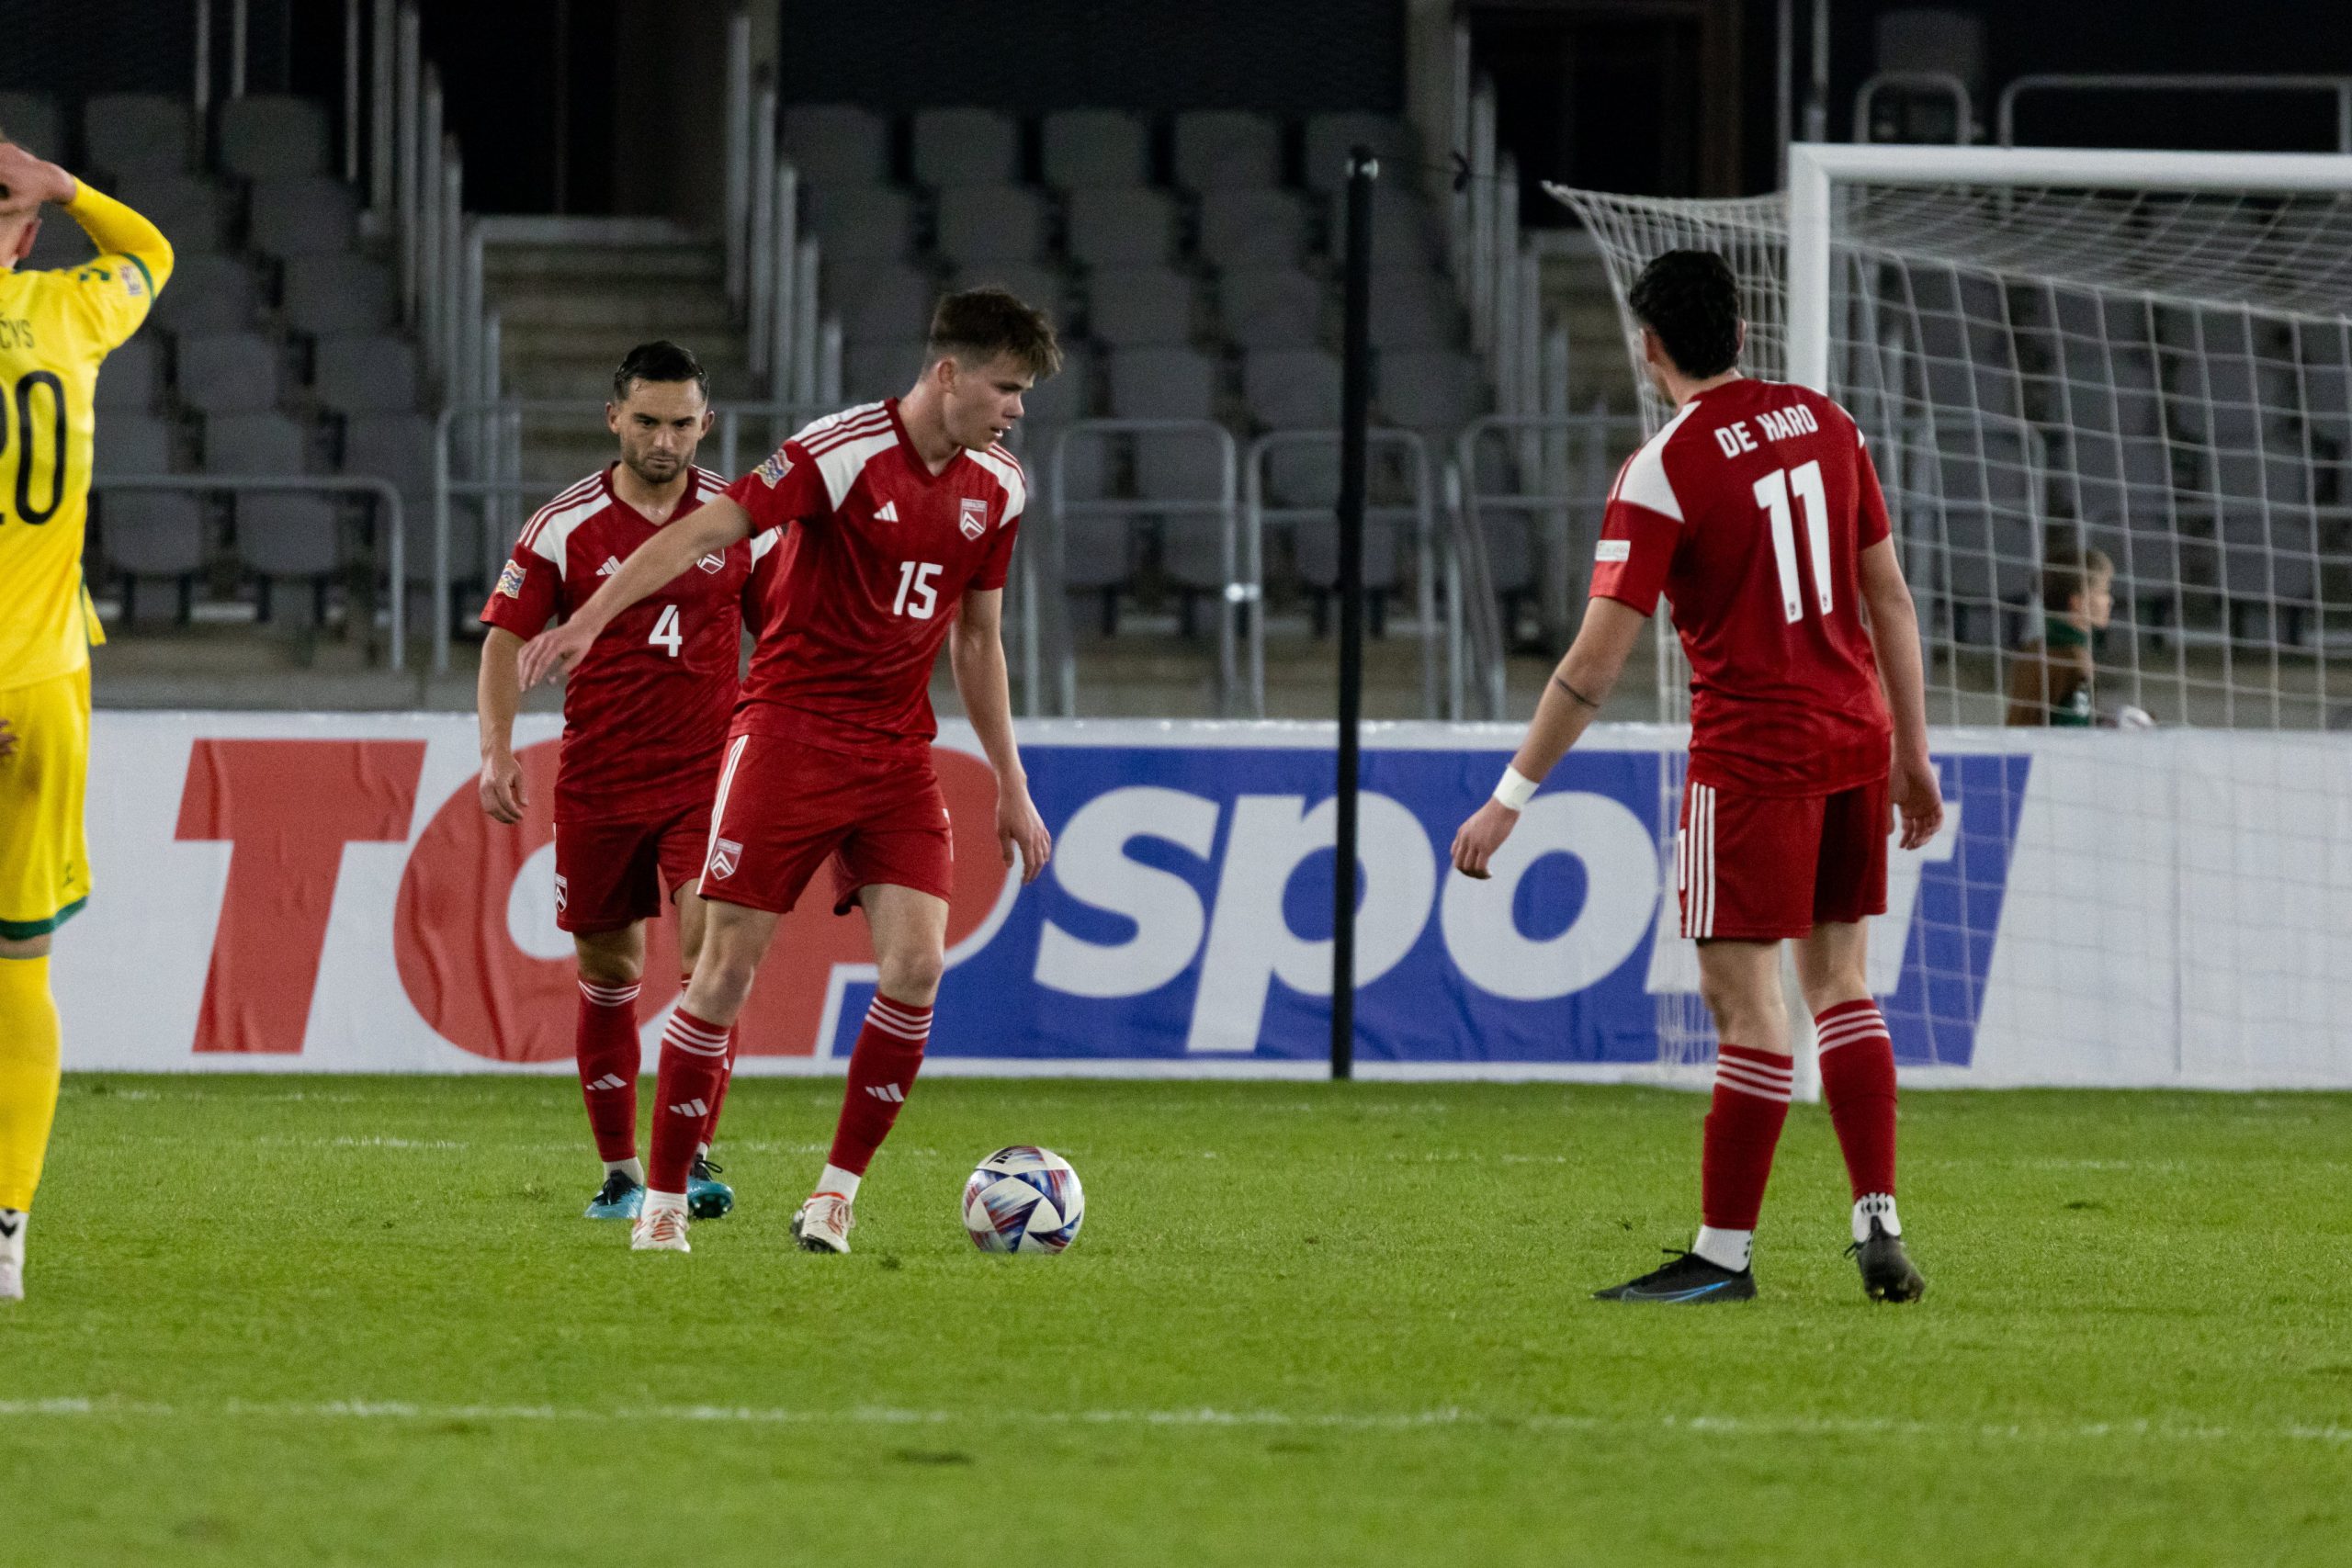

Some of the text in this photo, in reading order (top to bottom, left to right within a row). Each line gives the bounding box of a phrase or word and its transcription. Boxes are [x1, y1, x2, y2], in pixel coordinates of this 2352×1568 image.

[0, 370, 66, 525] 0
[1713, 421, 1758, 458] DE
[1753, 459, 1833, 624] 11
[893, 560, 944, 620] 15
[649, 604, 683, 657] 4
